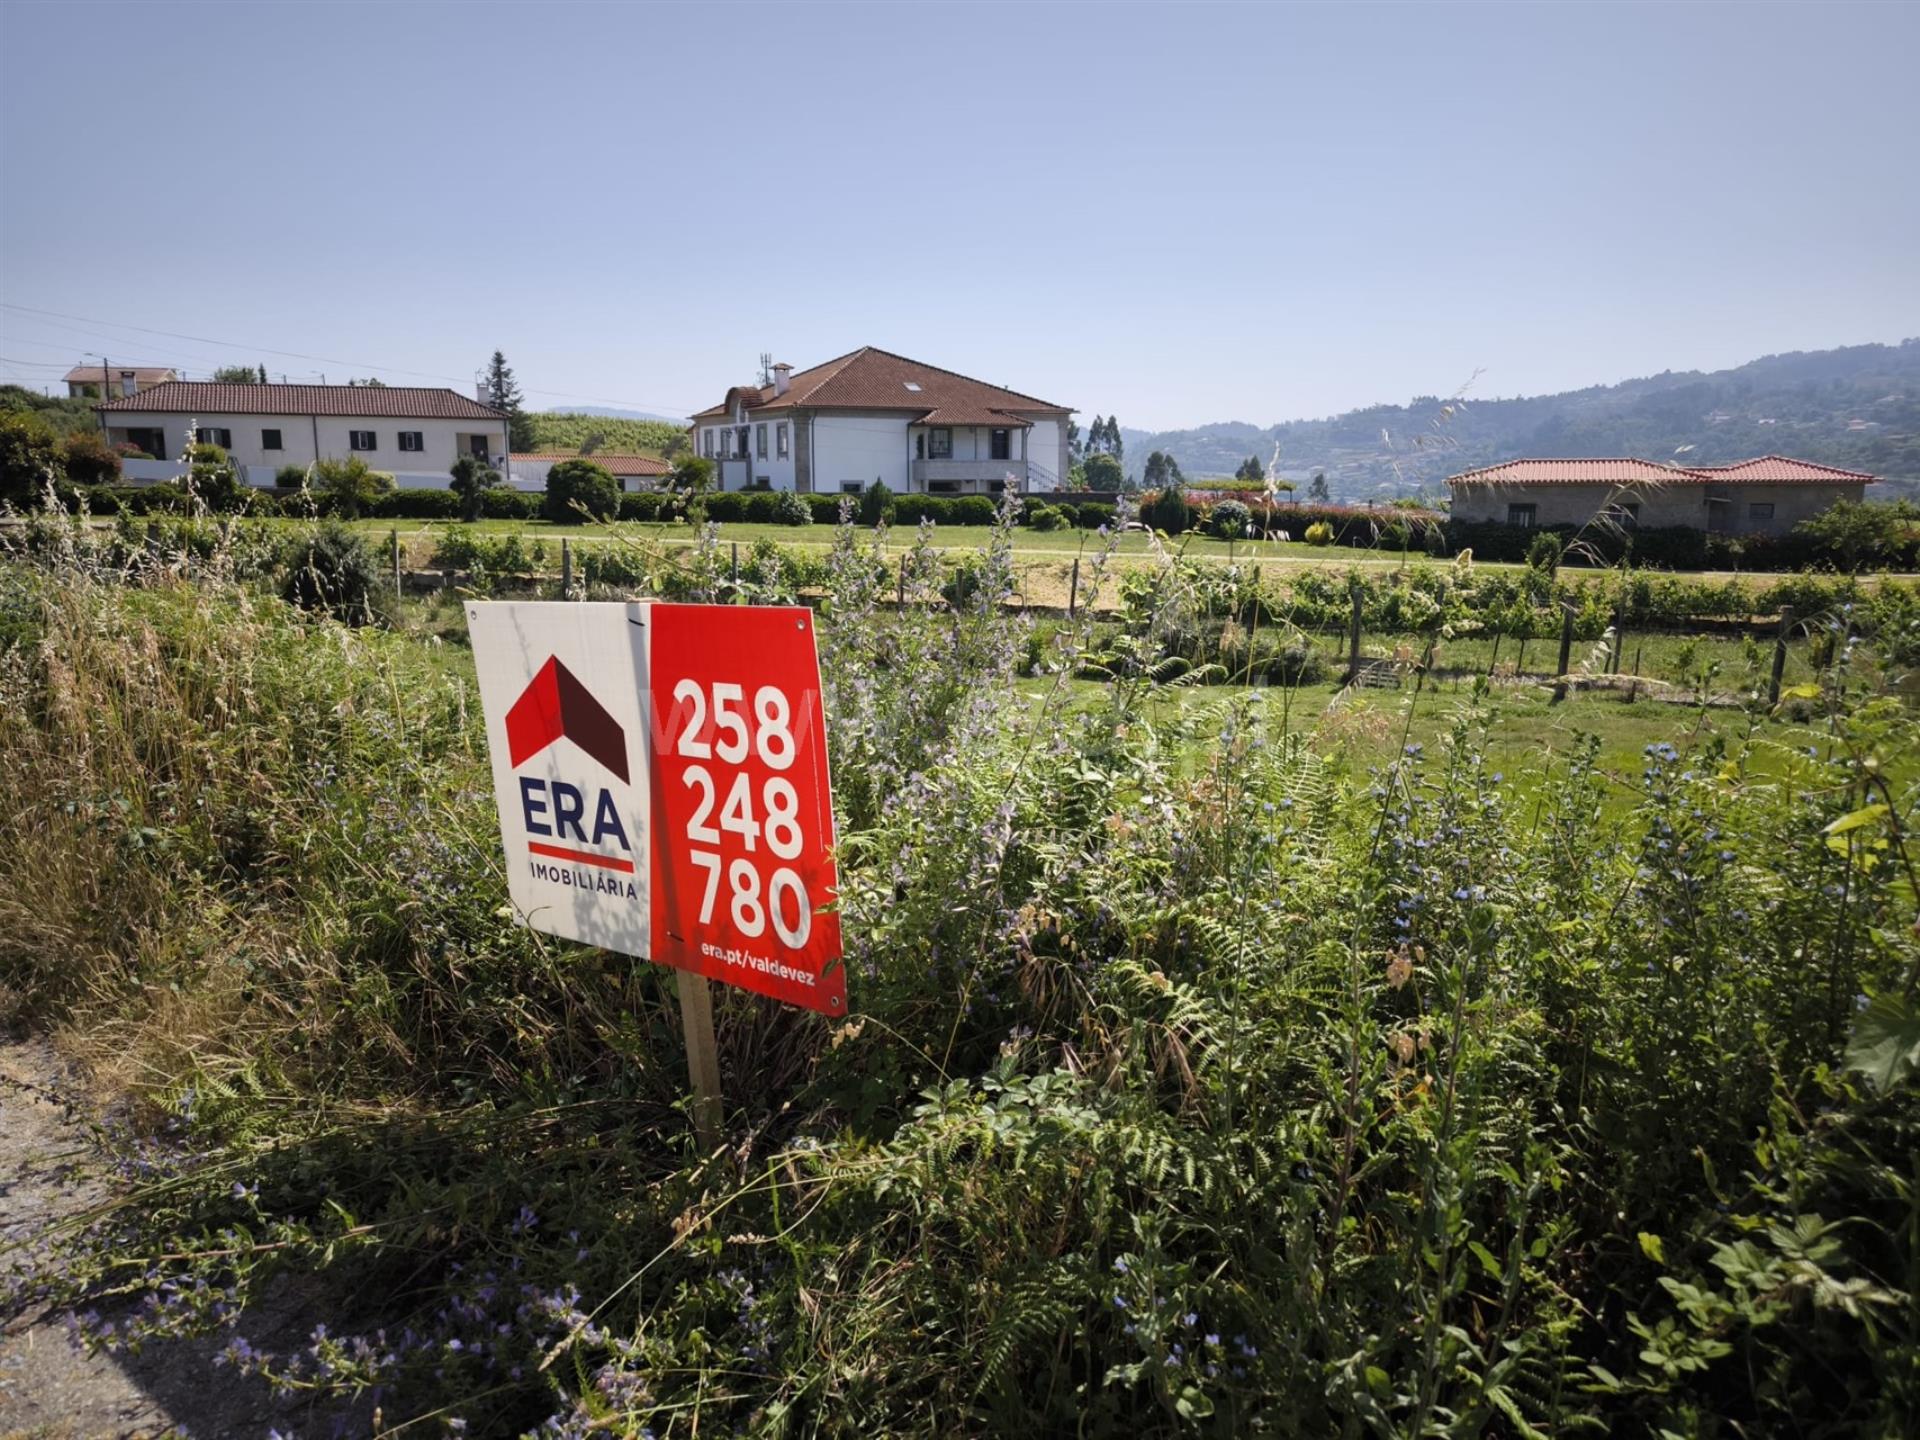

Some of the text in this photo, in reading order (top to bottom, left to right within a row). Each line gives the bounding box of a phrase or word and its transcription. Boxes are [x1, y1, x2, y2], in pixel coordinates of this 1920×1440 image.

[673, 678, 795, 770] 258
[520, 776, 631, 851] ERA
[682, 764, 803, 860] 248
[531, 862, 637, 900] IMOBILIÁRIA
[691, 849, 811, 949] 780
[702, 944, 815, 985] era.pt/valdevez
